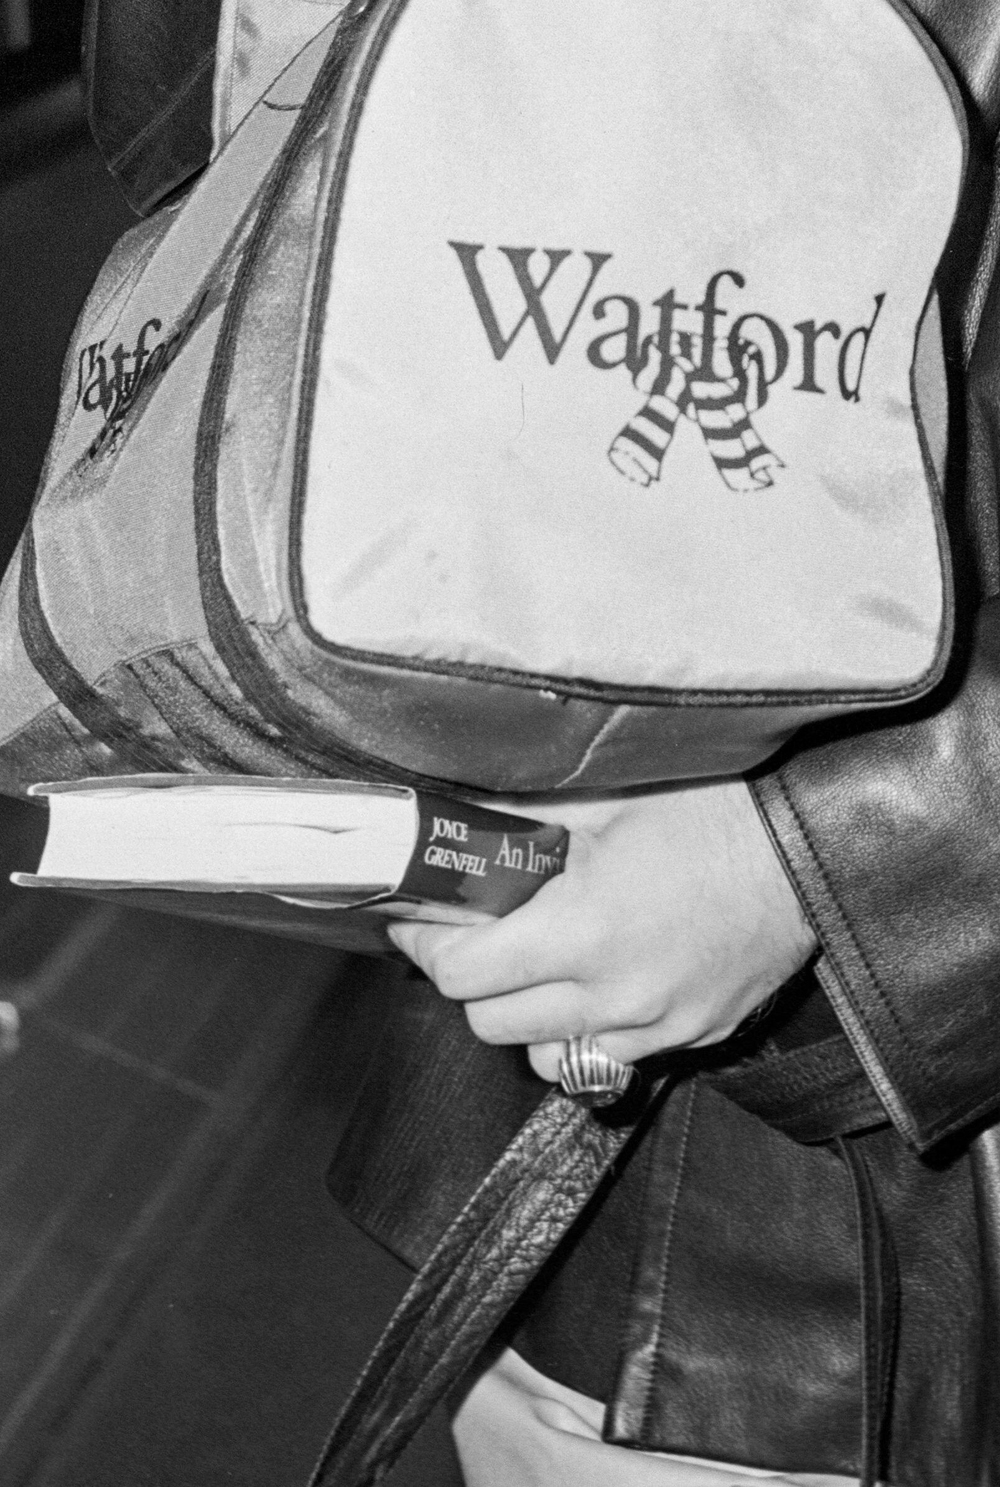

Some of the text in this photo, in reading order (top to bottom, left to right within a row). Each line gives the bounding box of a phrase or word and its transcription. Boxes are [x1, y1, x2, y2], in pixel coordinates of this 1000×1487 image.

[447, 239, 886, 403] Watford
[429, 816, 469, 842] JOYCE
[424, 845, 487, 877] GRENFELL
[494, 833, 523, 869] An
